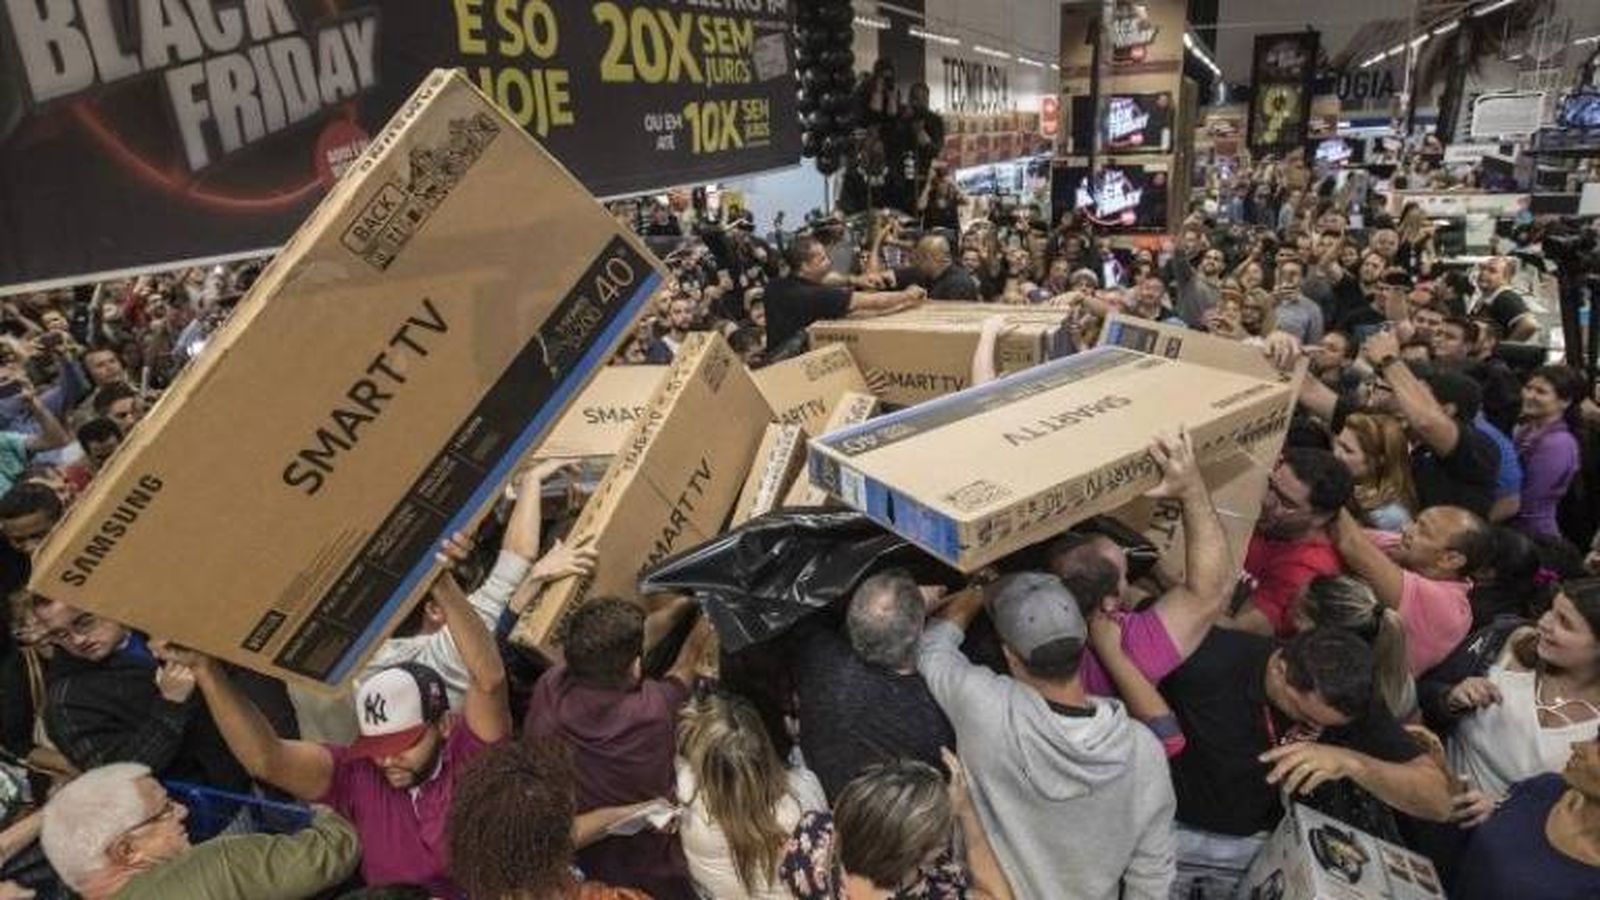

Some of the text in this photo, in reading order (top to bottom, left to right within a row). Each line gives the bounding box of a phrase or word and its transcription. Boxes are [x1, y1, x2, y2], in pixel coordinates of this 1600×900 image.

[592, 3, 704, 83] 20X
[699, 15, 754, 55] SEM
[165, 17, 378, 172] FRIDAY
[683, 100, 744, 154] 10X
[353, 193, 397, 243] BACK
[283, 352, 407, 496] SMART
[389, 298, 450, 357] TV
[61, 473, 163, 587] SAMSUNG
